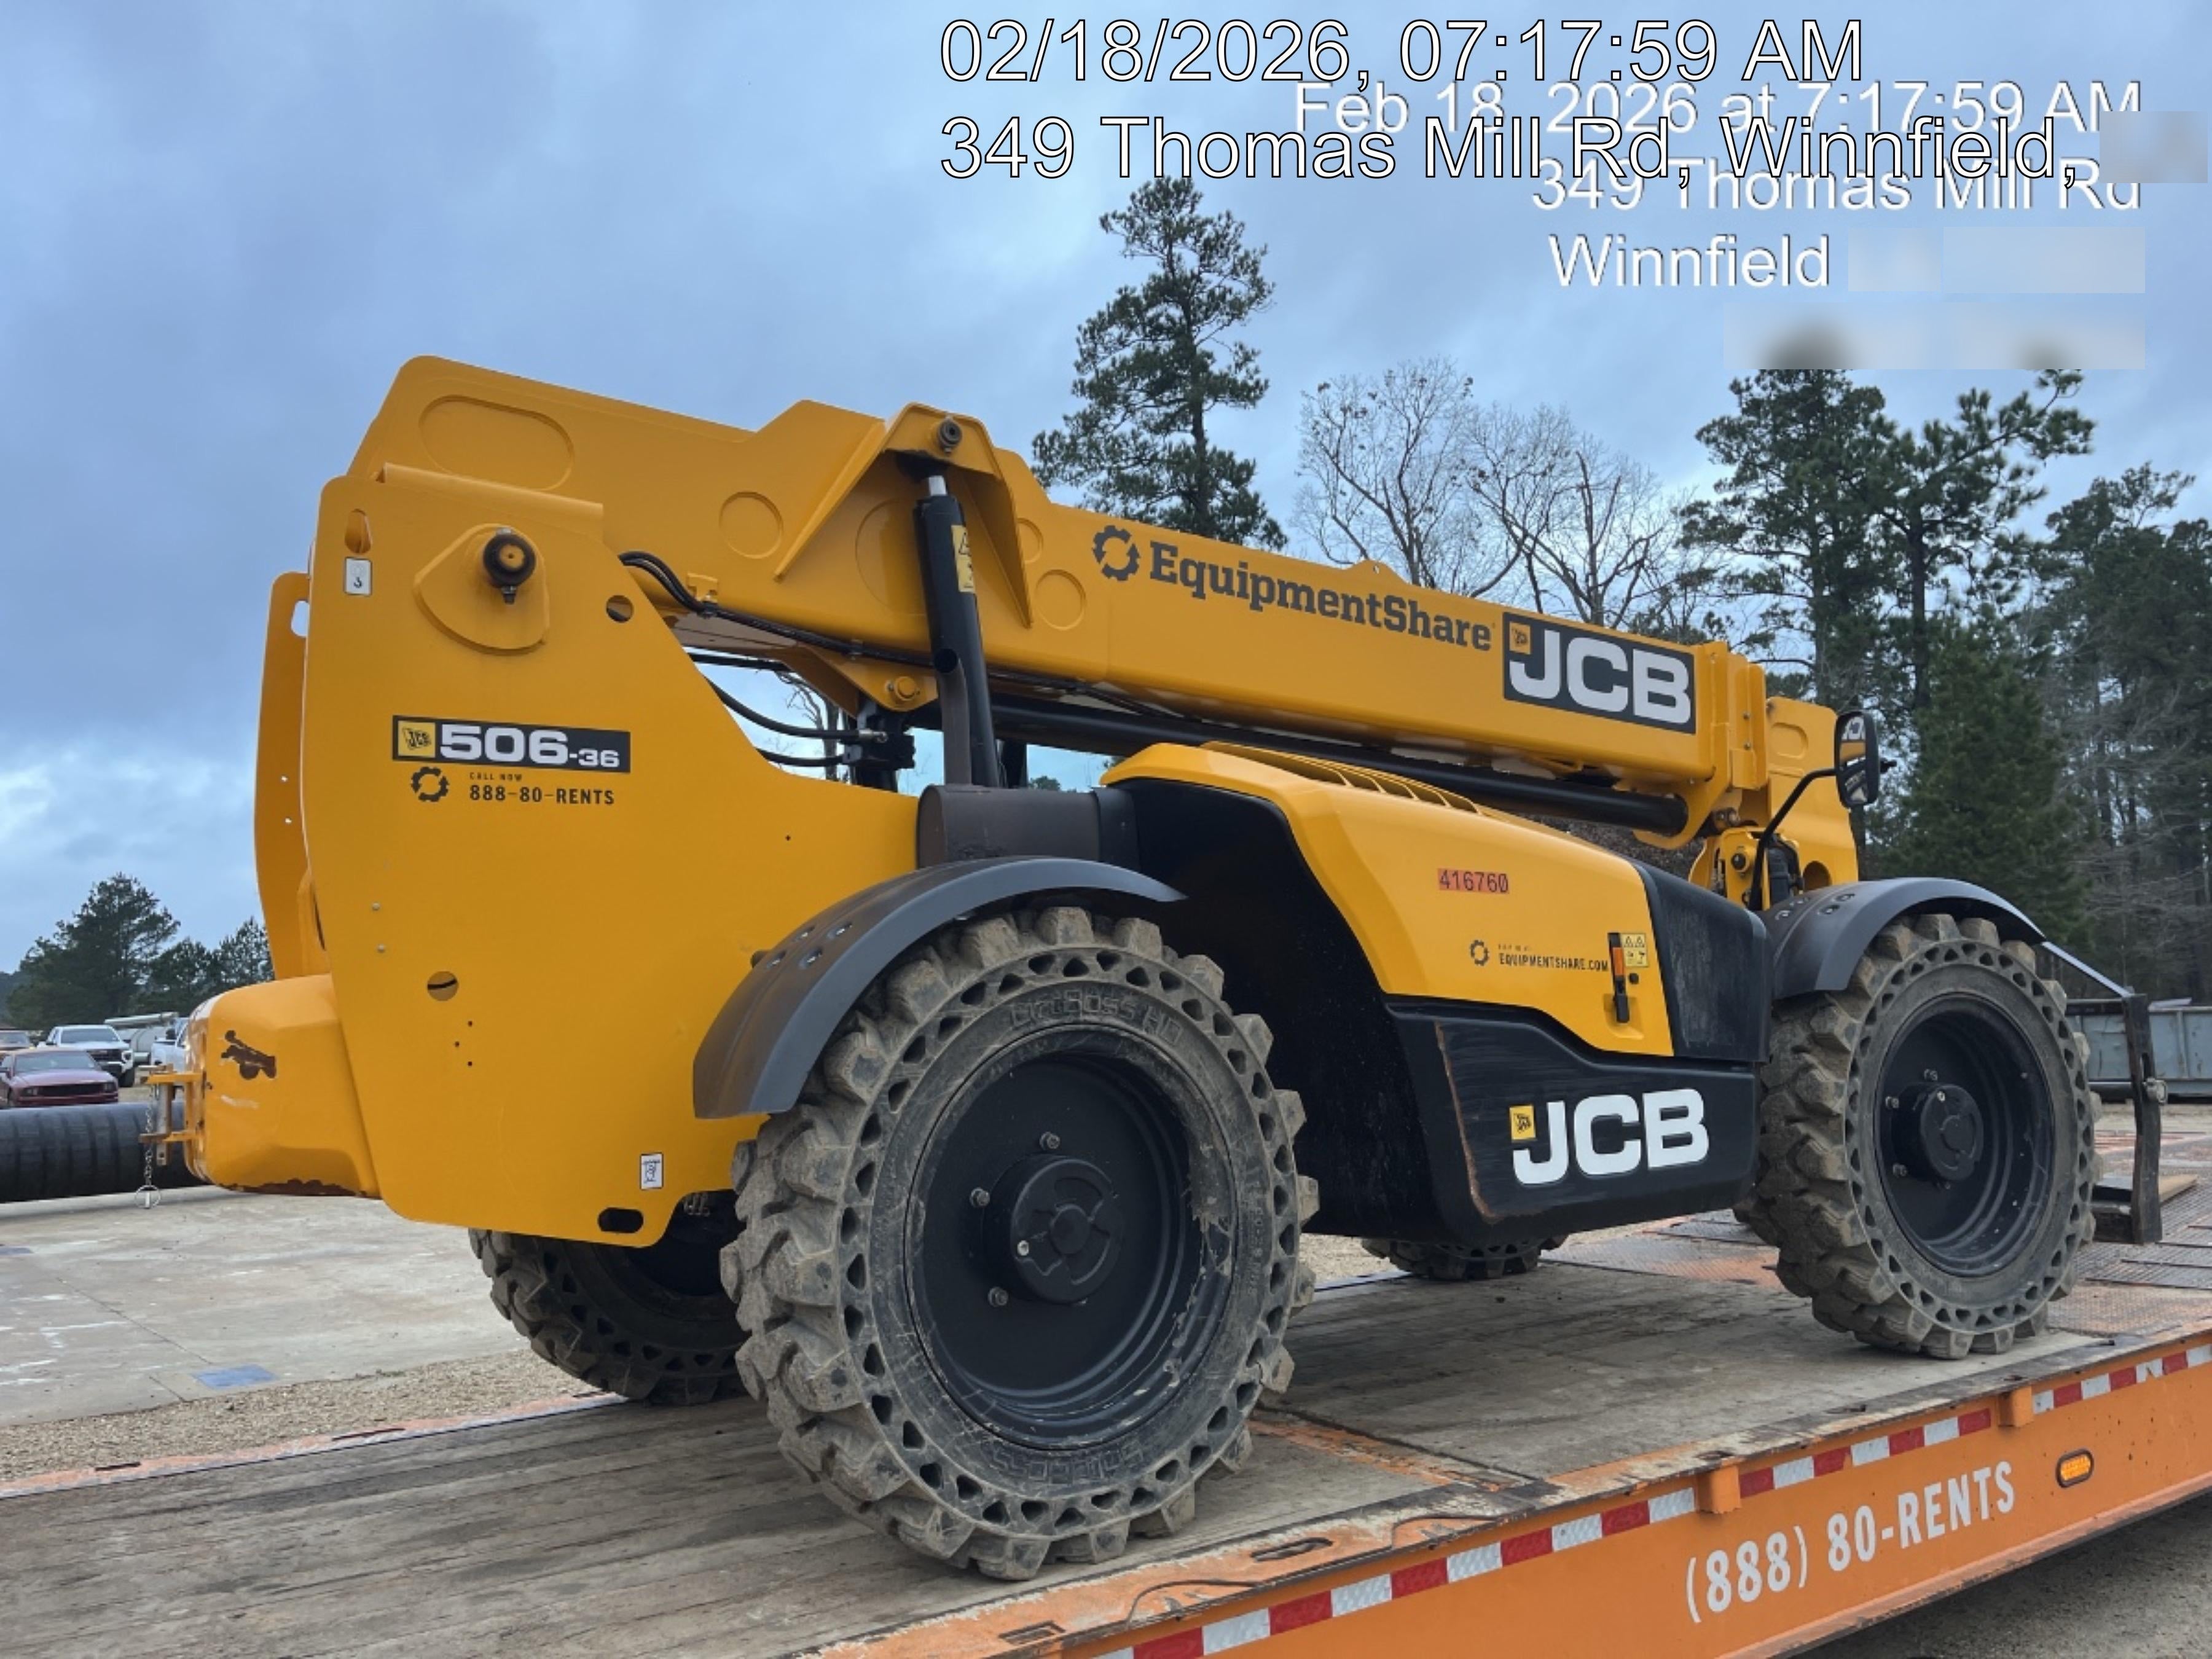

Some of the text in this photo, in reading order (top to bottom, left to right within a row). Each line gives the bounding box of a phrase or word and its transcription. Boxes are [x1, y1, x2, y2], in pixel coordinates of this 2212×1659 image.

[1150, 540, 1492, 651] EquipmentShare
[1509, 629, 1691, 724] JCB
[440, 724, 619, 767] 506-36
[469, 785, 614, 805] 888-80-RENTS
[1440, 869, 1508, 893] 416760
[1499, 953, 1608, 971] EQUIPMENTSHARE.COM
[1513, 1088, 1709, 1185] JCB
[1686, 1461, 2014, 1623] (888) 80-RENTS
